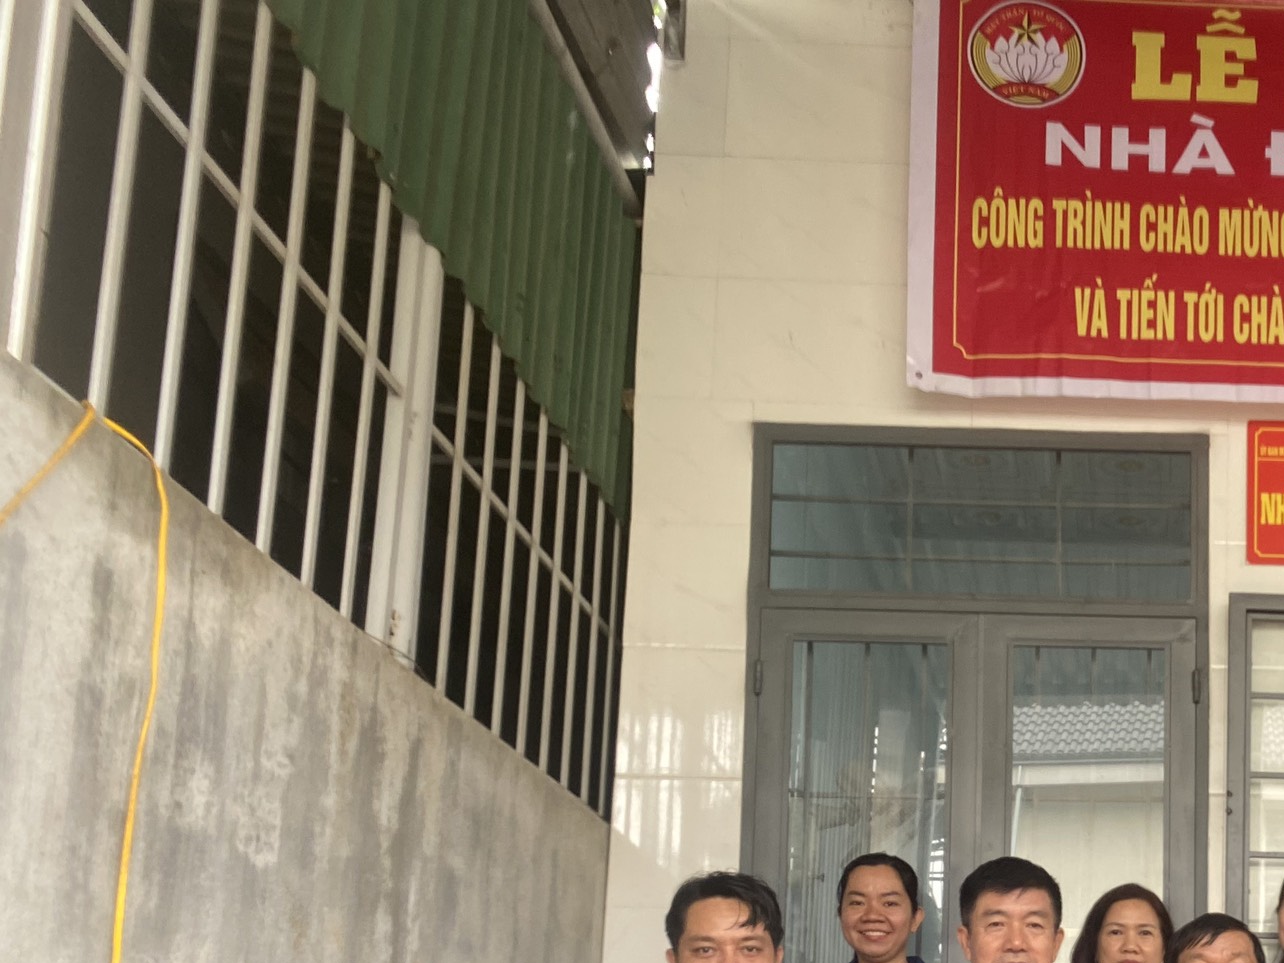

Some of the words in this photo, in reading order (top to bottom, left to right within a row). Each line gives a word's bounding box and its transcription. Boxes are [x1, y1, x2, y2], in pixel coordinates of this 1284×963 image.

[1132, 9, 1258, 103] LỄ
[1045, 114, 1234, 174] NHÀ
[972, 187, 1043, 248] CÔNG
[1053, 191, 1130, 250] TRÌNH
[1140, 196, 1209, 255] CHÀO
[1075, 278, 1108, 338] VÀ
[1117, 274, 1175, 341] TIẾN
[1184, 282, 1224, 342] TỚI
